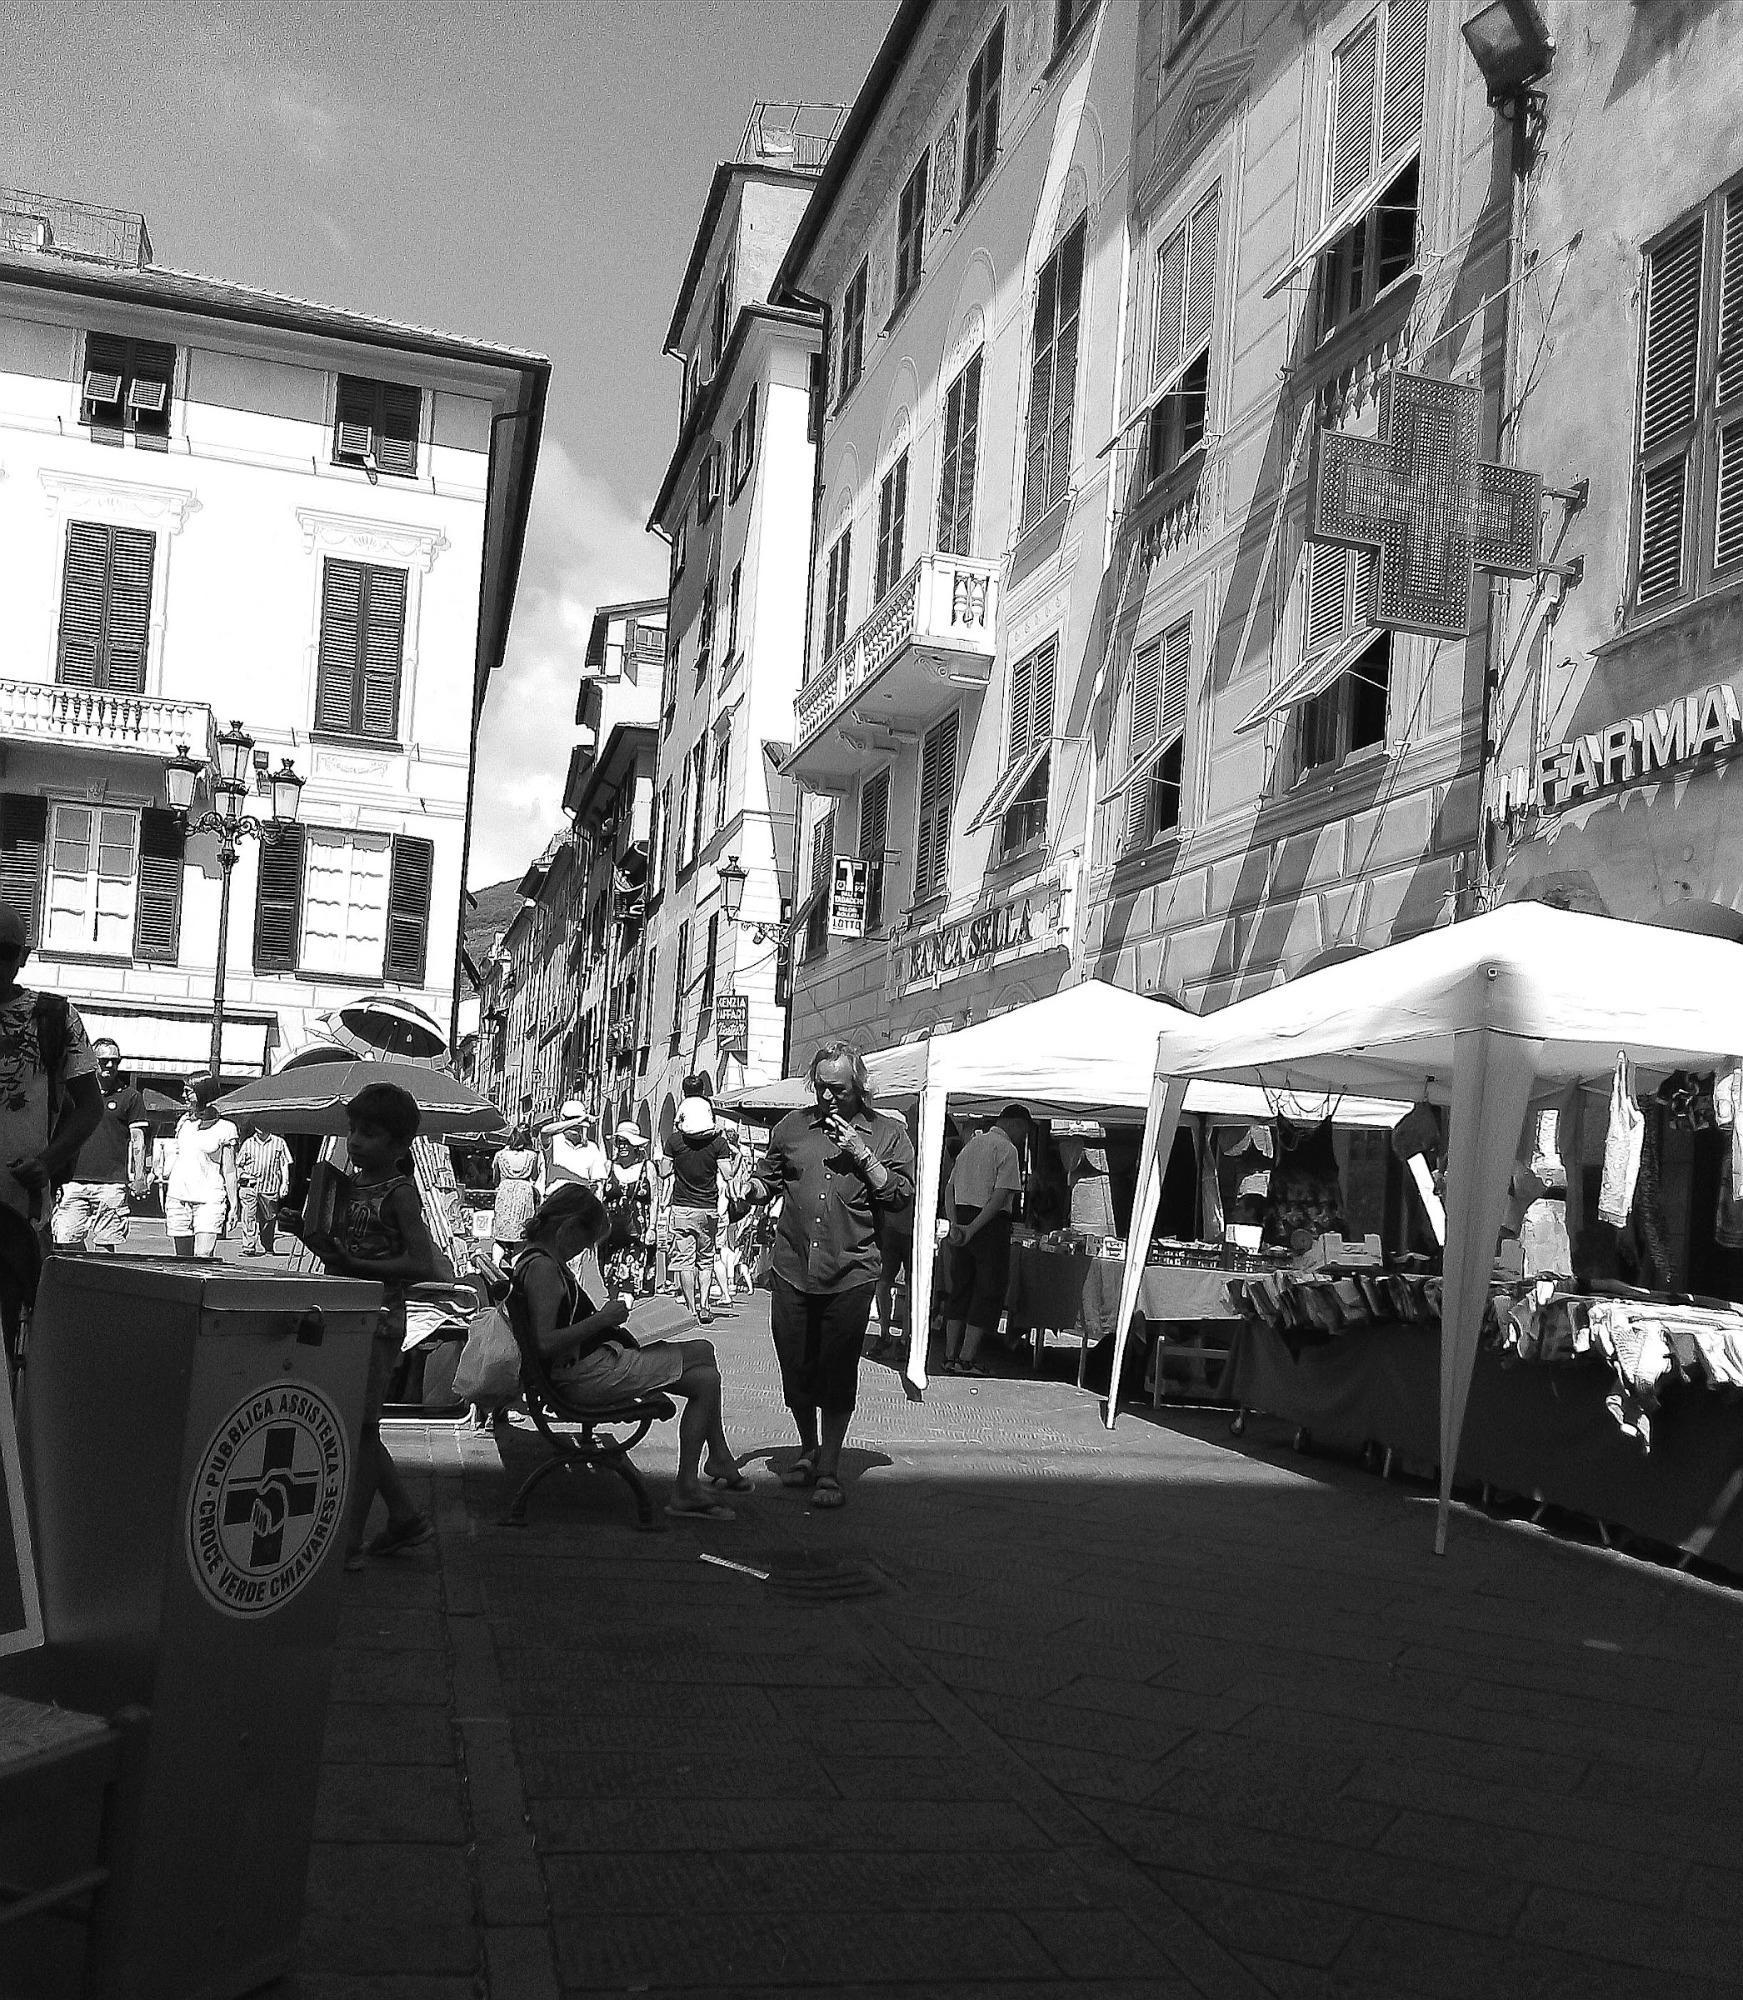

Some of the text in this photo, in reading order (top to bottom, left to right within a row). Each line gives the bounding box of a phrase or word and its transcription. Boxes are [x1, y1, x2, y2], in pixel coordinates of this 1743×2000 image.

[1536, 683, 1741, 807] FARMA
[833, 918, 862, 929] LOTTO
[968, 898, 1033, 960] SELLA
[205, 1393, 340, 1488] PUBBLICA ASSISTENZA
[199, 1485, 339, 1602] CROCE VERDE CHIAVARESE
